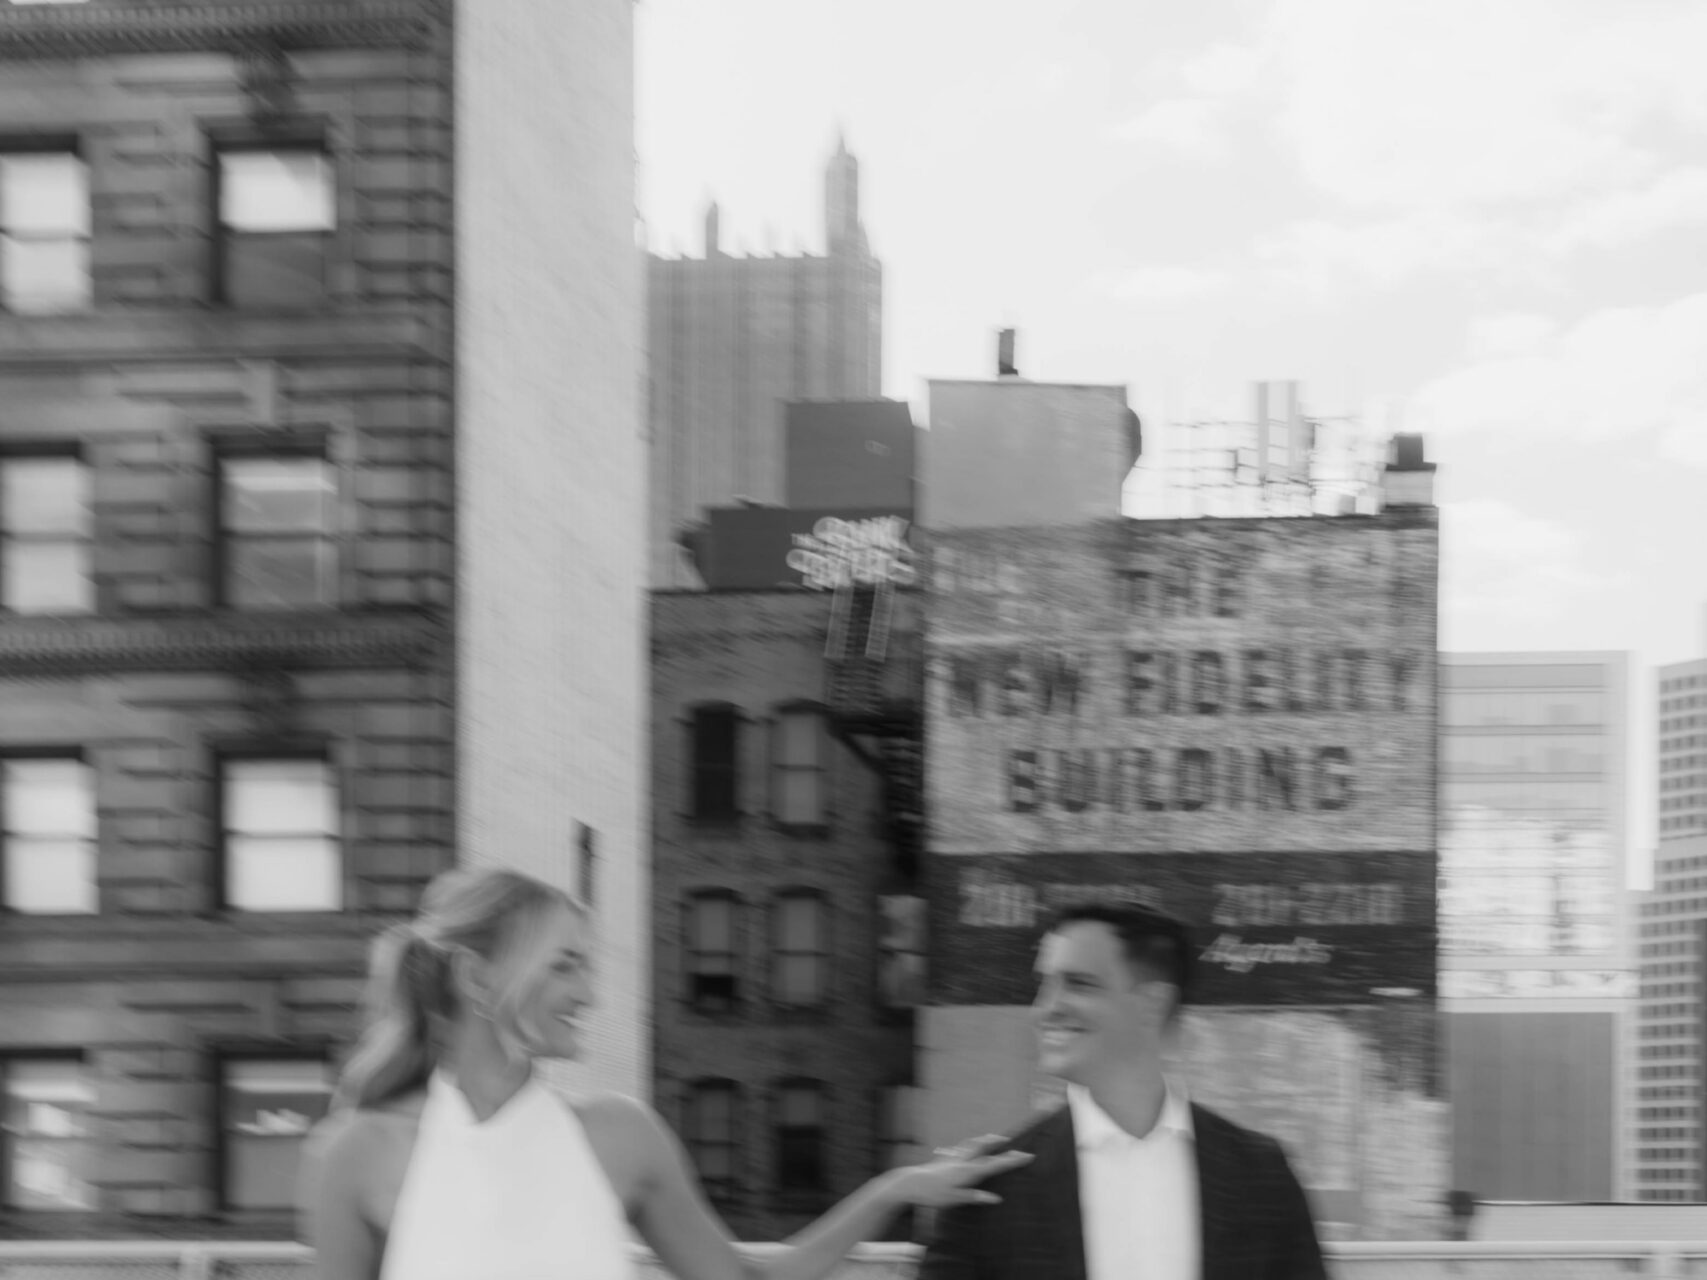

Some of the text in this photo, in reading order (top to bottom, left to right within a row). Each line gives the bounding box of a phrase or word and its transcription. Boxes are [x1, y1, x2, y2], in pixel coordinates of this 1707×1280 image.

[950, 648, 1423, 717] NEW FIDELITY
[1008, 747, 1355, 812] BUILDING
